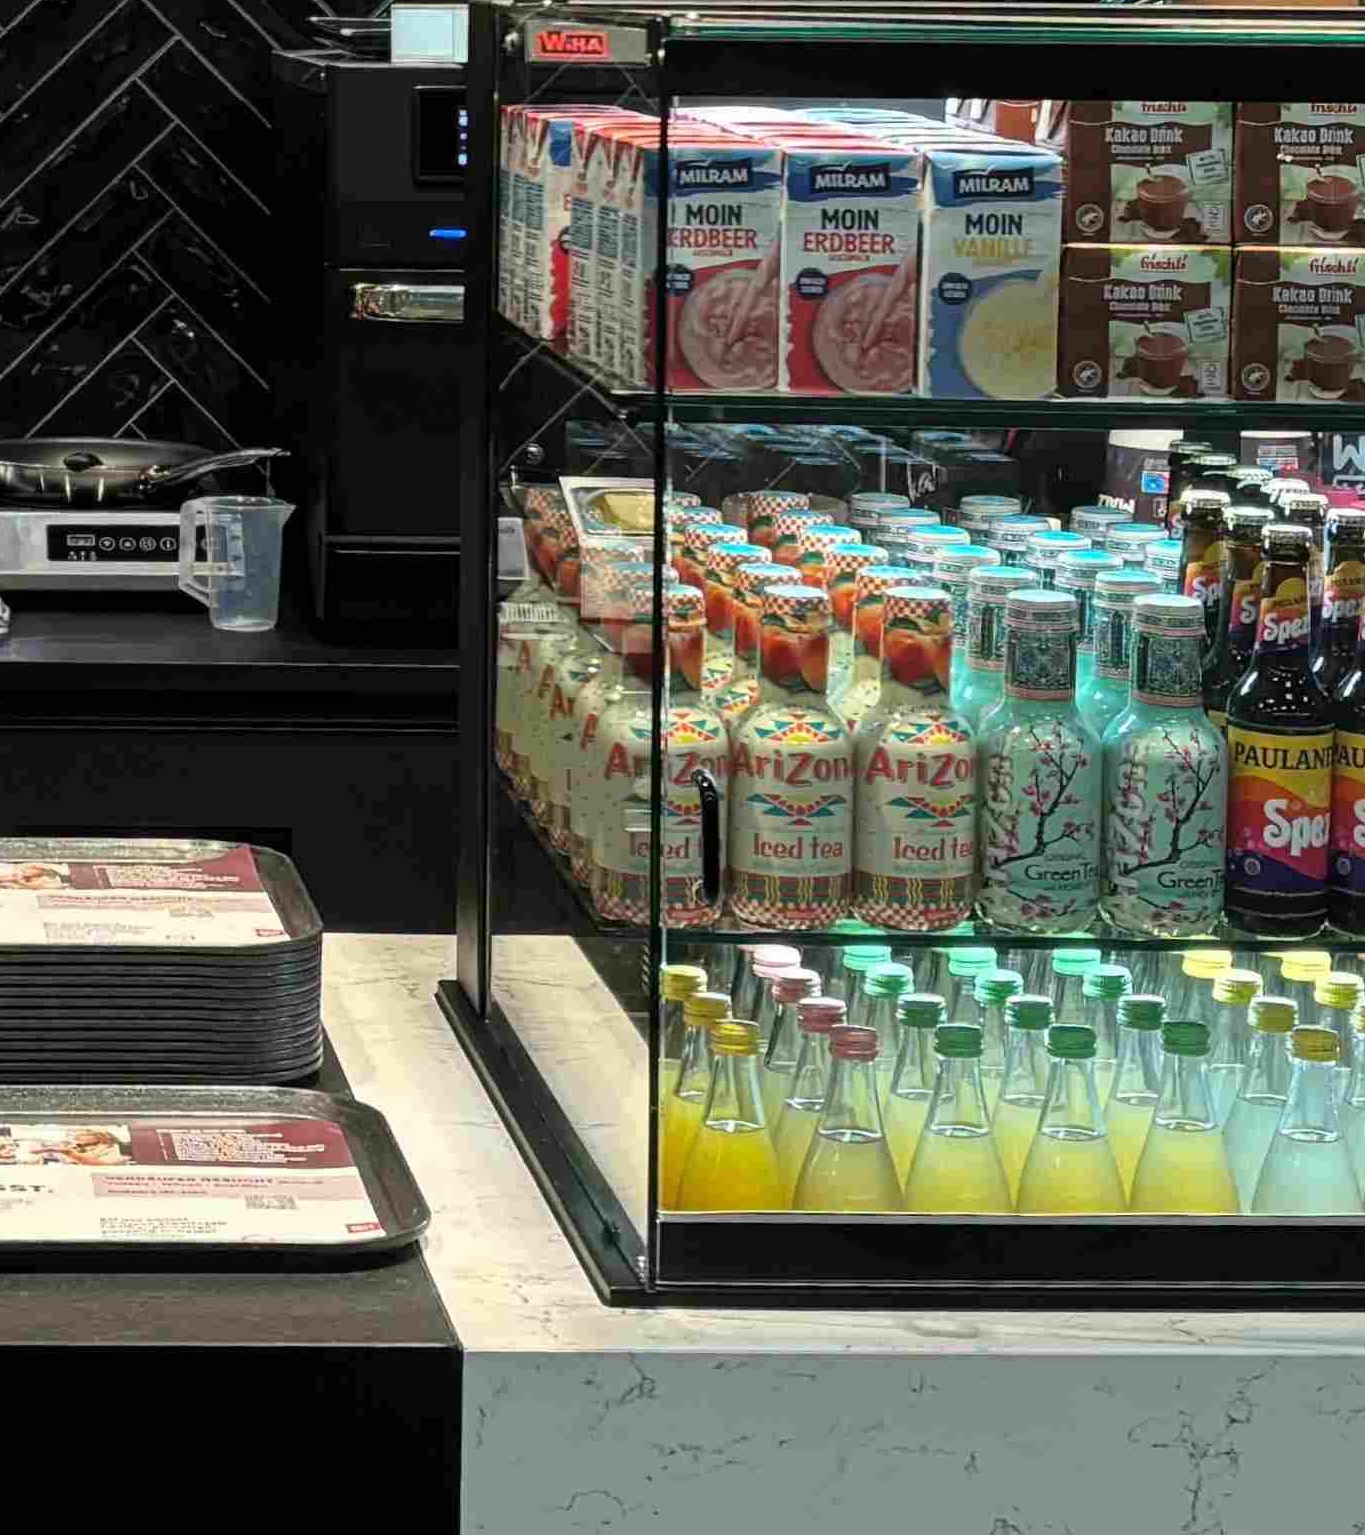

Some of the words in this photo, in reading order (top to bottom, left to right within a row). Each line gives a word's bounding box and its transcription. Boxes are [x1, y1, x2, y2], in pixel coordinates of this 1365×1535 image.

[1105, 128, 1146, 143] Kakao
[680, 169, 748, 184] MILRAM
[815, 171, 885, 190] MILRAM
[958, 176, 1029, 195] MILRAM
[686, 205, 742, 225] MOIN
[821, 209, 879, 230] MOIN
[964, 213, 1022, 234] MOIN
[803, 231, 895, 254] ERDBEER
[732, 748, 849, 786] AriZon
[752, 837, 803, 859] Iced
[811, 838, 844, 859] tea
